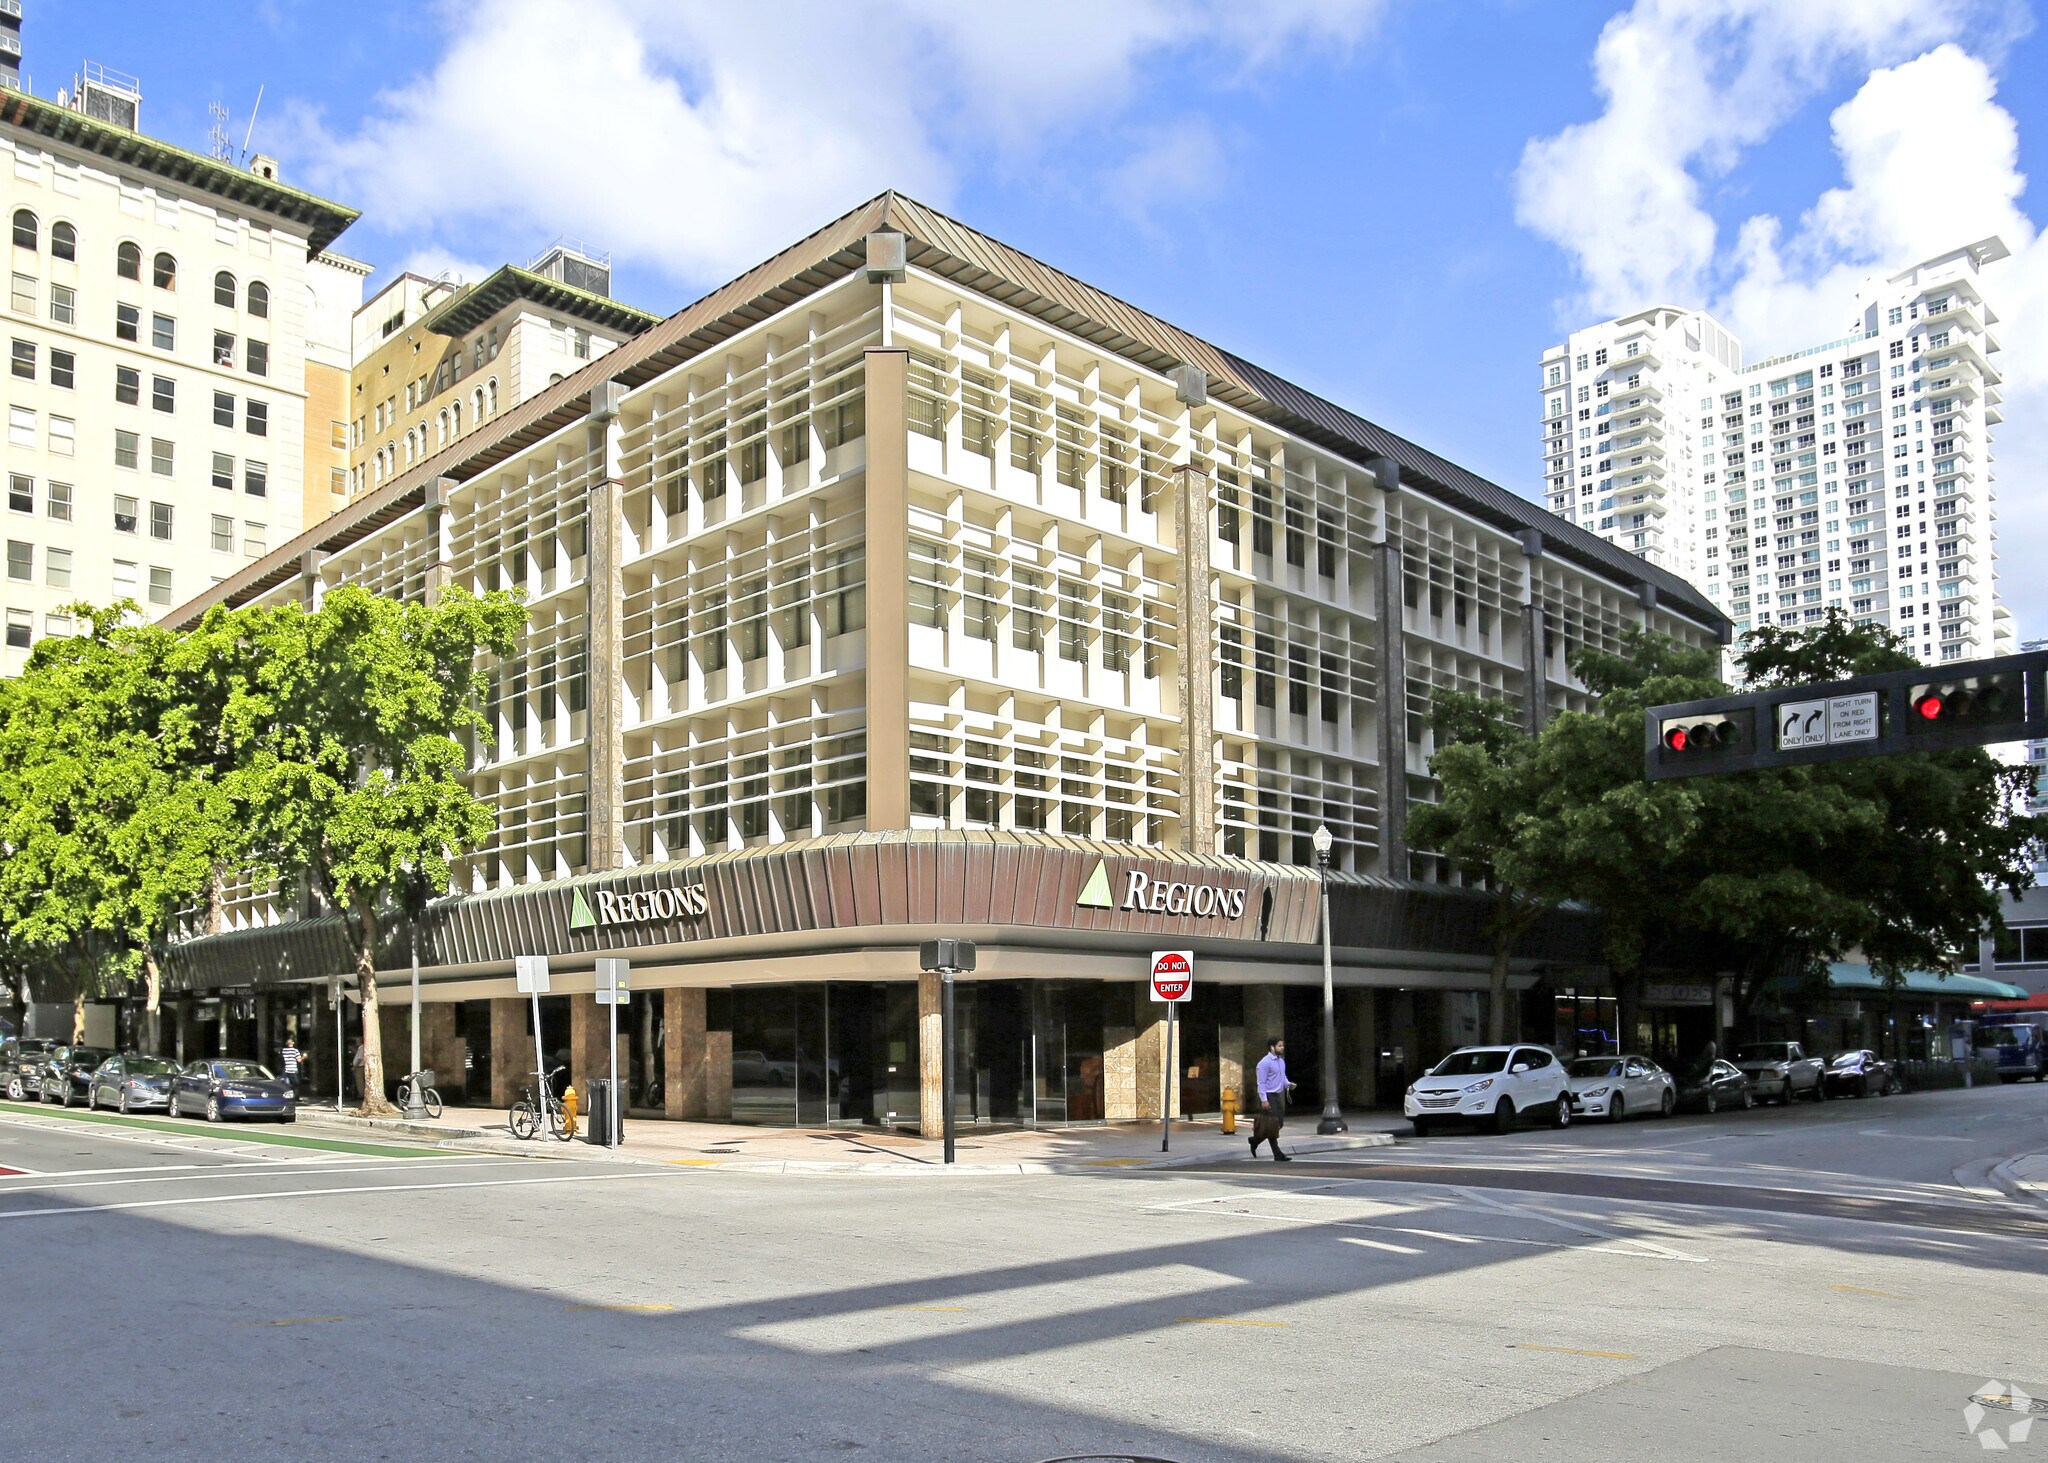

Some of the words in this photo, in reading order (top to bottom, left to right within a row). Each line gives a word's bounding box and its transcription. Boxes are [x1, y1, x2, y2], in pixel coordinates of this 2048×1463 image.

[1833, 700, 1851, 708] RIGHT
[1854, 698, 1871, 706] TURN
[1833, 720, 1851, 728] FROM
[1853, 718, 1872, 726] RIGHT
[1834, 730, 1852, 738] LANE
[1854, 728, 1871, 736] ONLY
[1783, 736, 1802, 745] ONLY
[1805, 734, 1824, 743] ONLY
[1122, 870, 1246, 919] REGIONS
[595, 883, 707, 926] REGIONS
[1158, 962, 1168, 970] DO
[1172, 961, 1186, 970] NOT
[1160, 984, 1183, 992] ENTER
